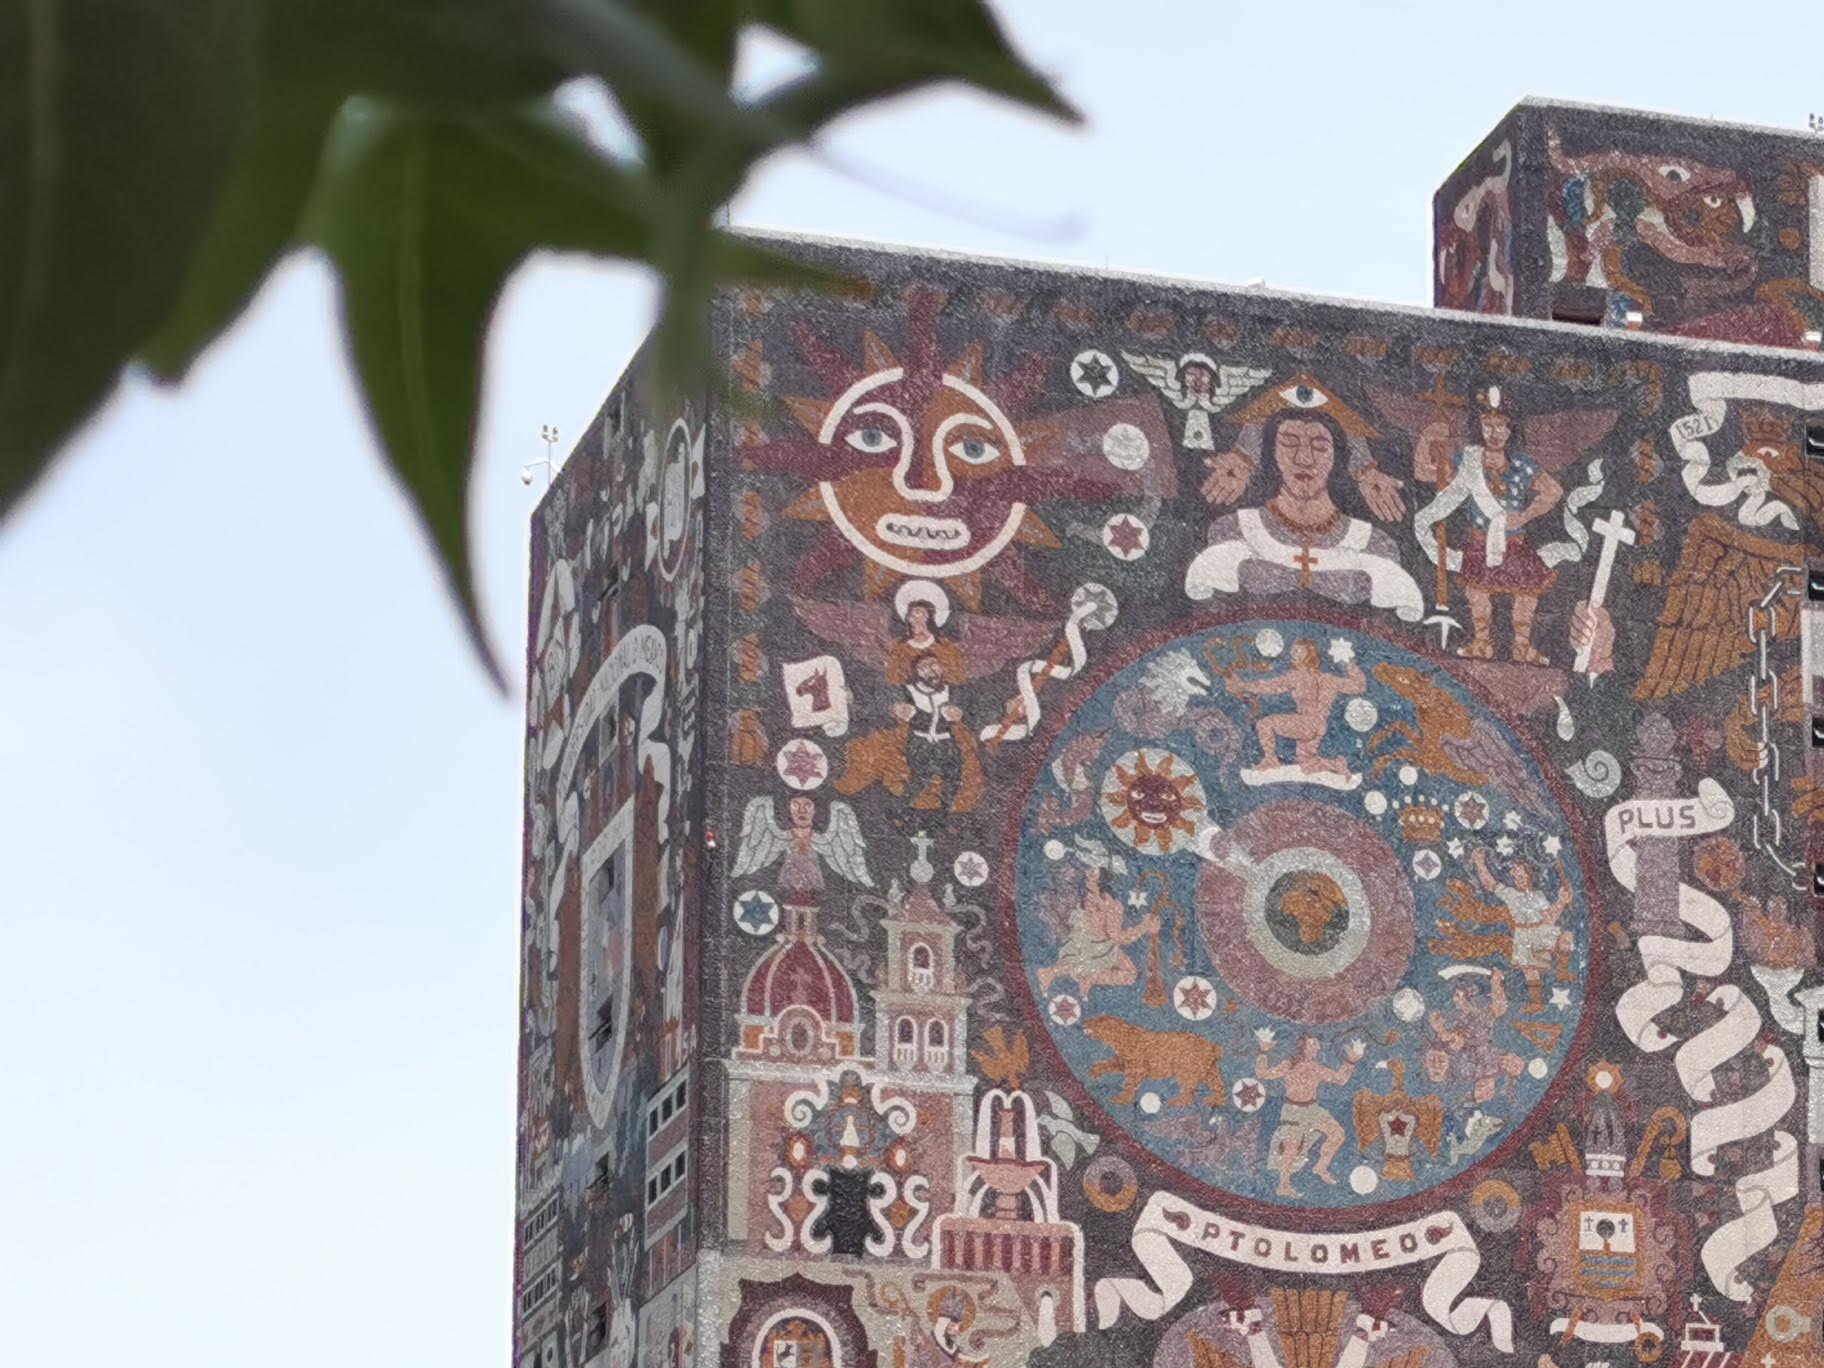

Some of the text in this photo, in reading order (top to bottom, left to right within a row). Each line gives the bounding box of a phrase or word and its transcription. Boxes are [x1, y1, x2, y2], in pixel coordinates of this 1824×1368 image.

[1676, 416, 1713, 439] 1521
[1618, 805, 1696, 834] PLUS
[1201, 1221, 1419, 1264] PTOLOMEO
